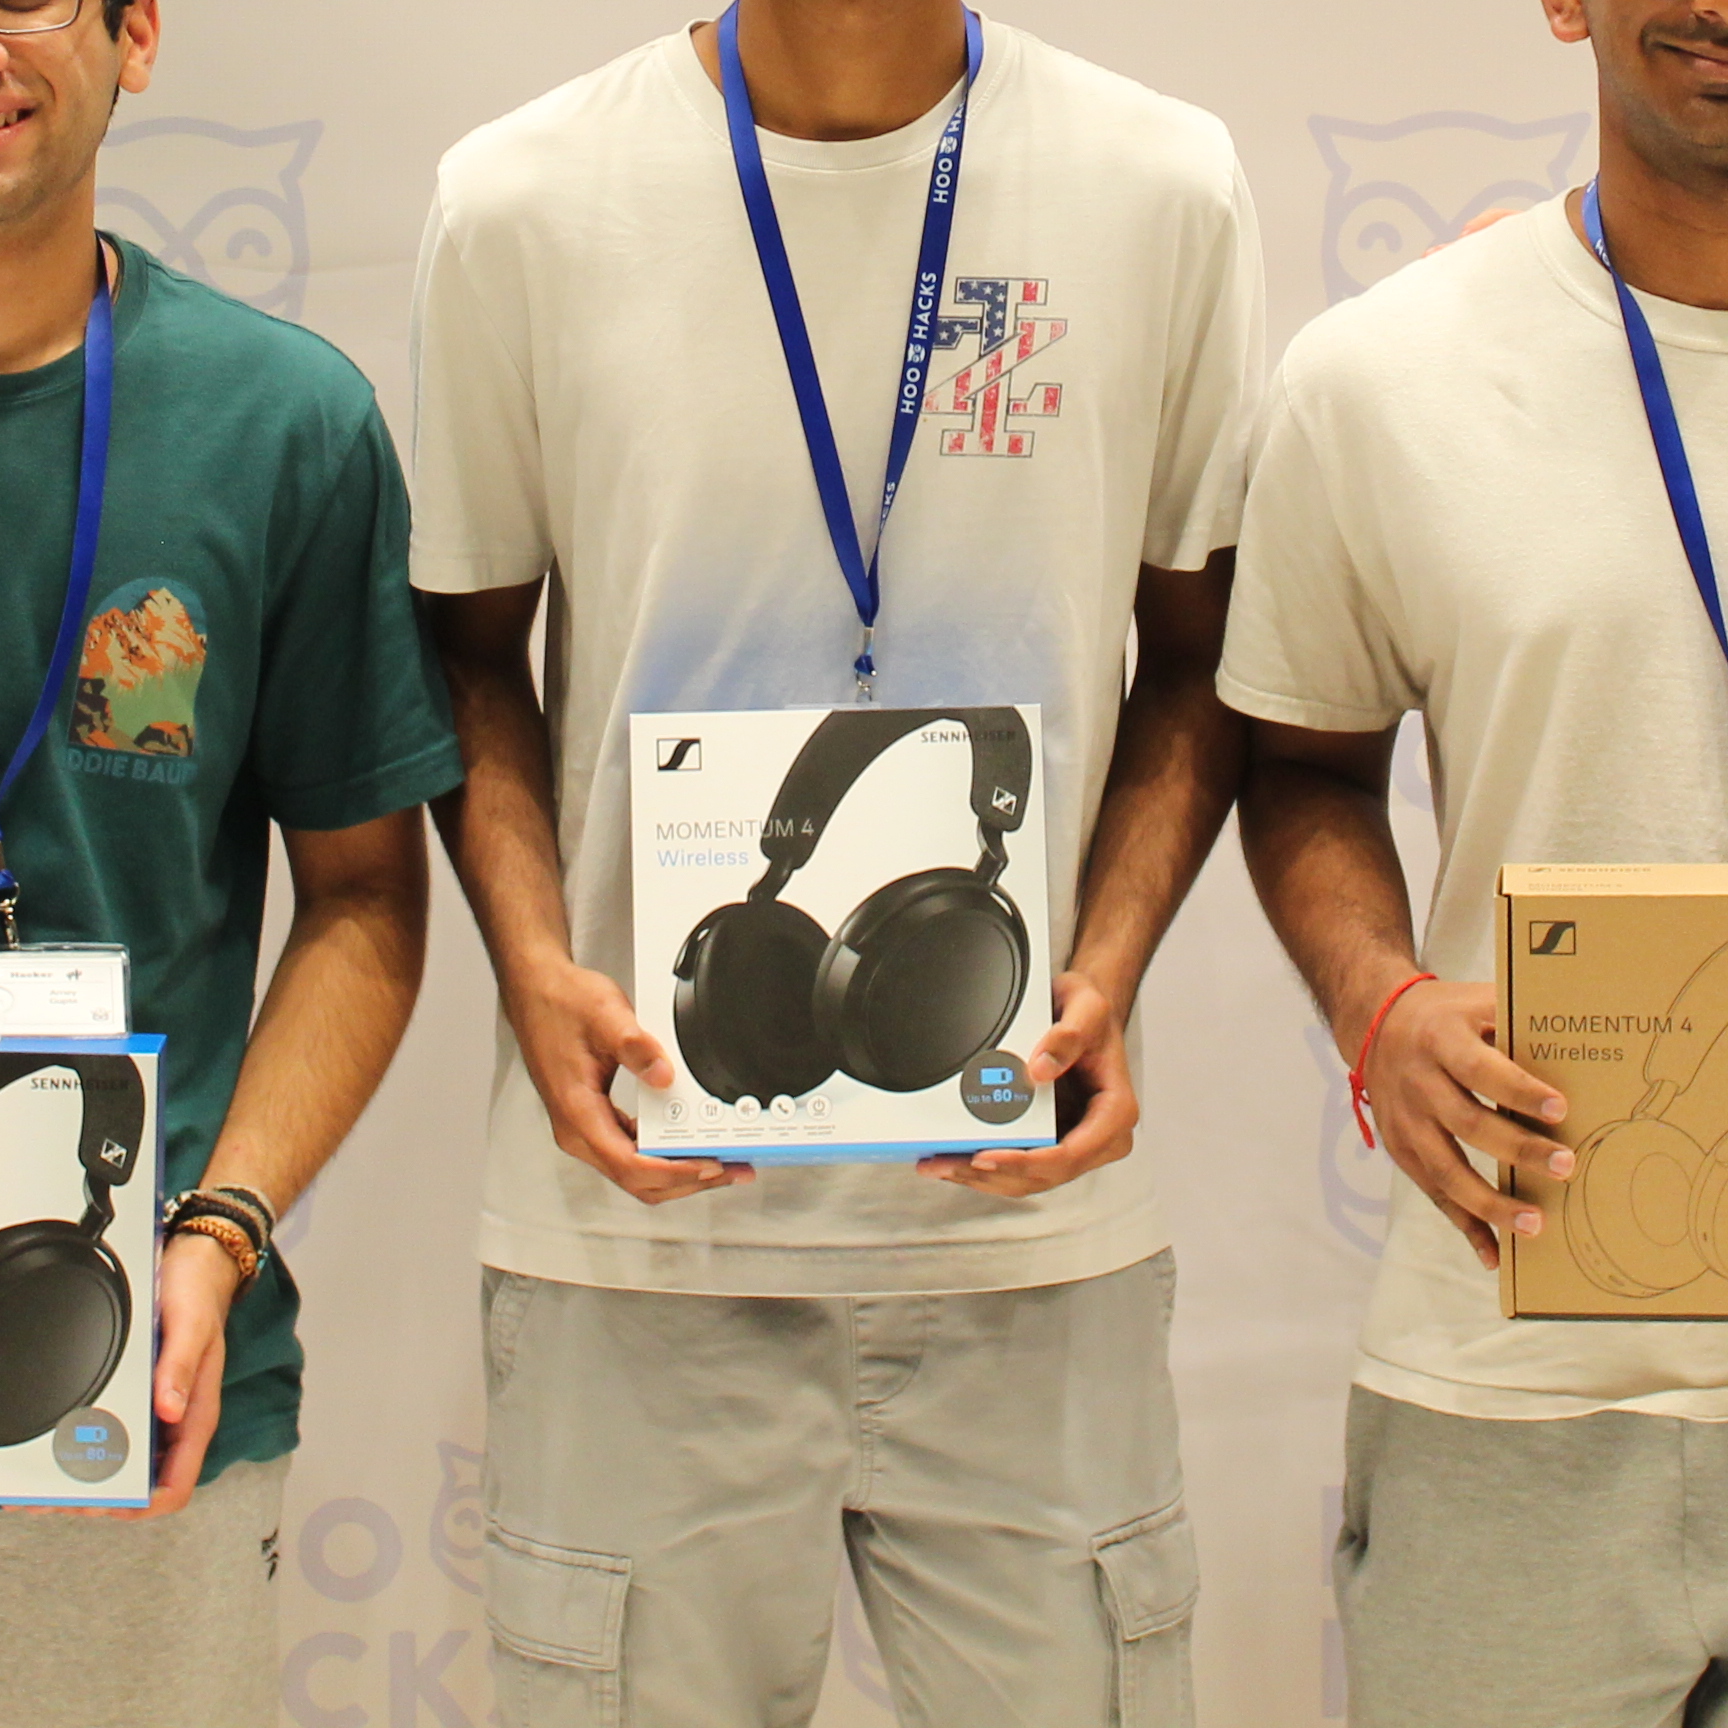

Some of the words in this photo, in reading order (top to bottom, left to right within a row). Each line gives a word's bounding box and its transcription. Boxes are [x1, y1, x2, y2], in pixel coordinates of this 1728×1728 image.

[933, 157, 953, 203] HOO
[900, 367, 922, 414] HOO
[913, 271, 937, 339] HACKS
[655, 818, 795, 841] MOMENTUM
[801, 821, 815, 837] 4
[657, 848, 749, 867] Wireless
[1529, 1015, 1673, 1033] MOMENTUM
[1680, 1016, 1692, 1033] 4
[1529, 1043, 1624, 1062] Wireless
[993, 1088, 1013, 1102] 60
